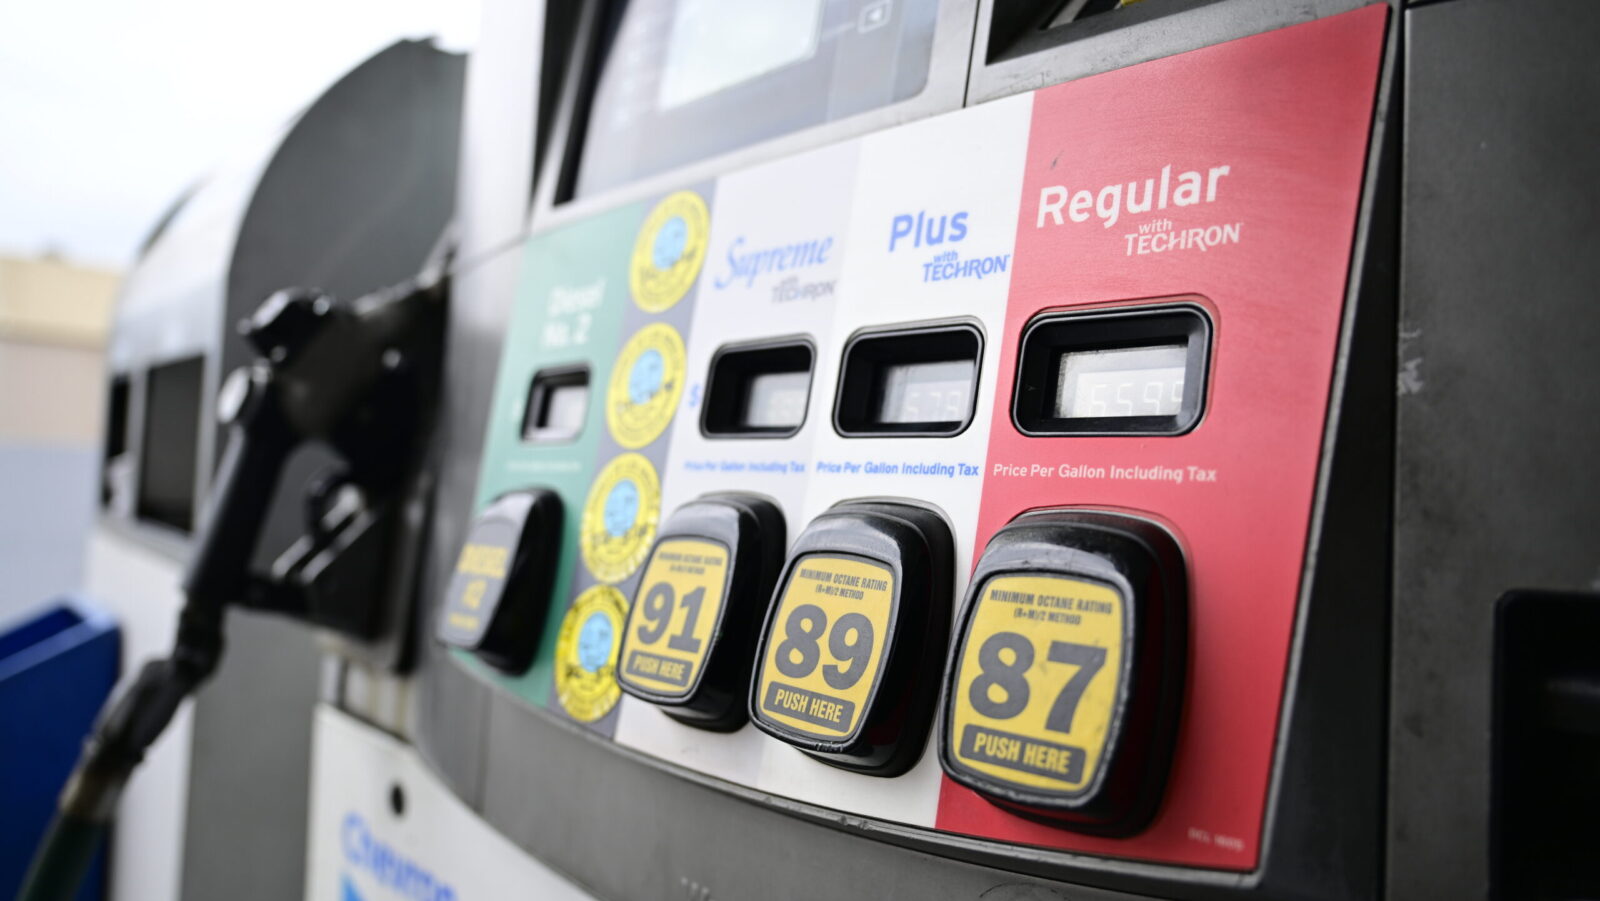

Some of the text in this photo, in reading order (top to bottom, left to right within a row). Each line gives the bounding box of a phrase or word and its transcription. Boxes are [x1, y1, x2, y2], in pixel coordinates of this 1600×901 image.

[1036, 163, 1231, 229] Regular
[888, 210, 969, 253] Plus
[1124, 222, 1242, 256] TECHRON
[1138, 218, 1172, 234] with
[713, 235, 834, 291] Supreme
[922, 254, 1009, 283] TECHRON
[933, 250, 958, 263] with
[816, 461, 980, 478] Price Per Gallon Including Tax
[992, 463, 1217, 483] Price Per Gallon Including Tax
[799, 568, 888, 591] MINIMUM OCTANE RATING
[840, 589, 864, 601] METHOD
[989, 589, 1113, 615] MINIMUM OCTANE RATING
[637, 581, 707, 654] 91
[1047, 612, 1082, 625] METHOD
[775, 603, 875, 691] 89
[632, 654, 685, 682] PUSH HERE
[968, 631, 1108, 734] 87
[774, 688, 844, 723] PUSH HERE
[973, 732, 1072, 774] PUSH HERE
